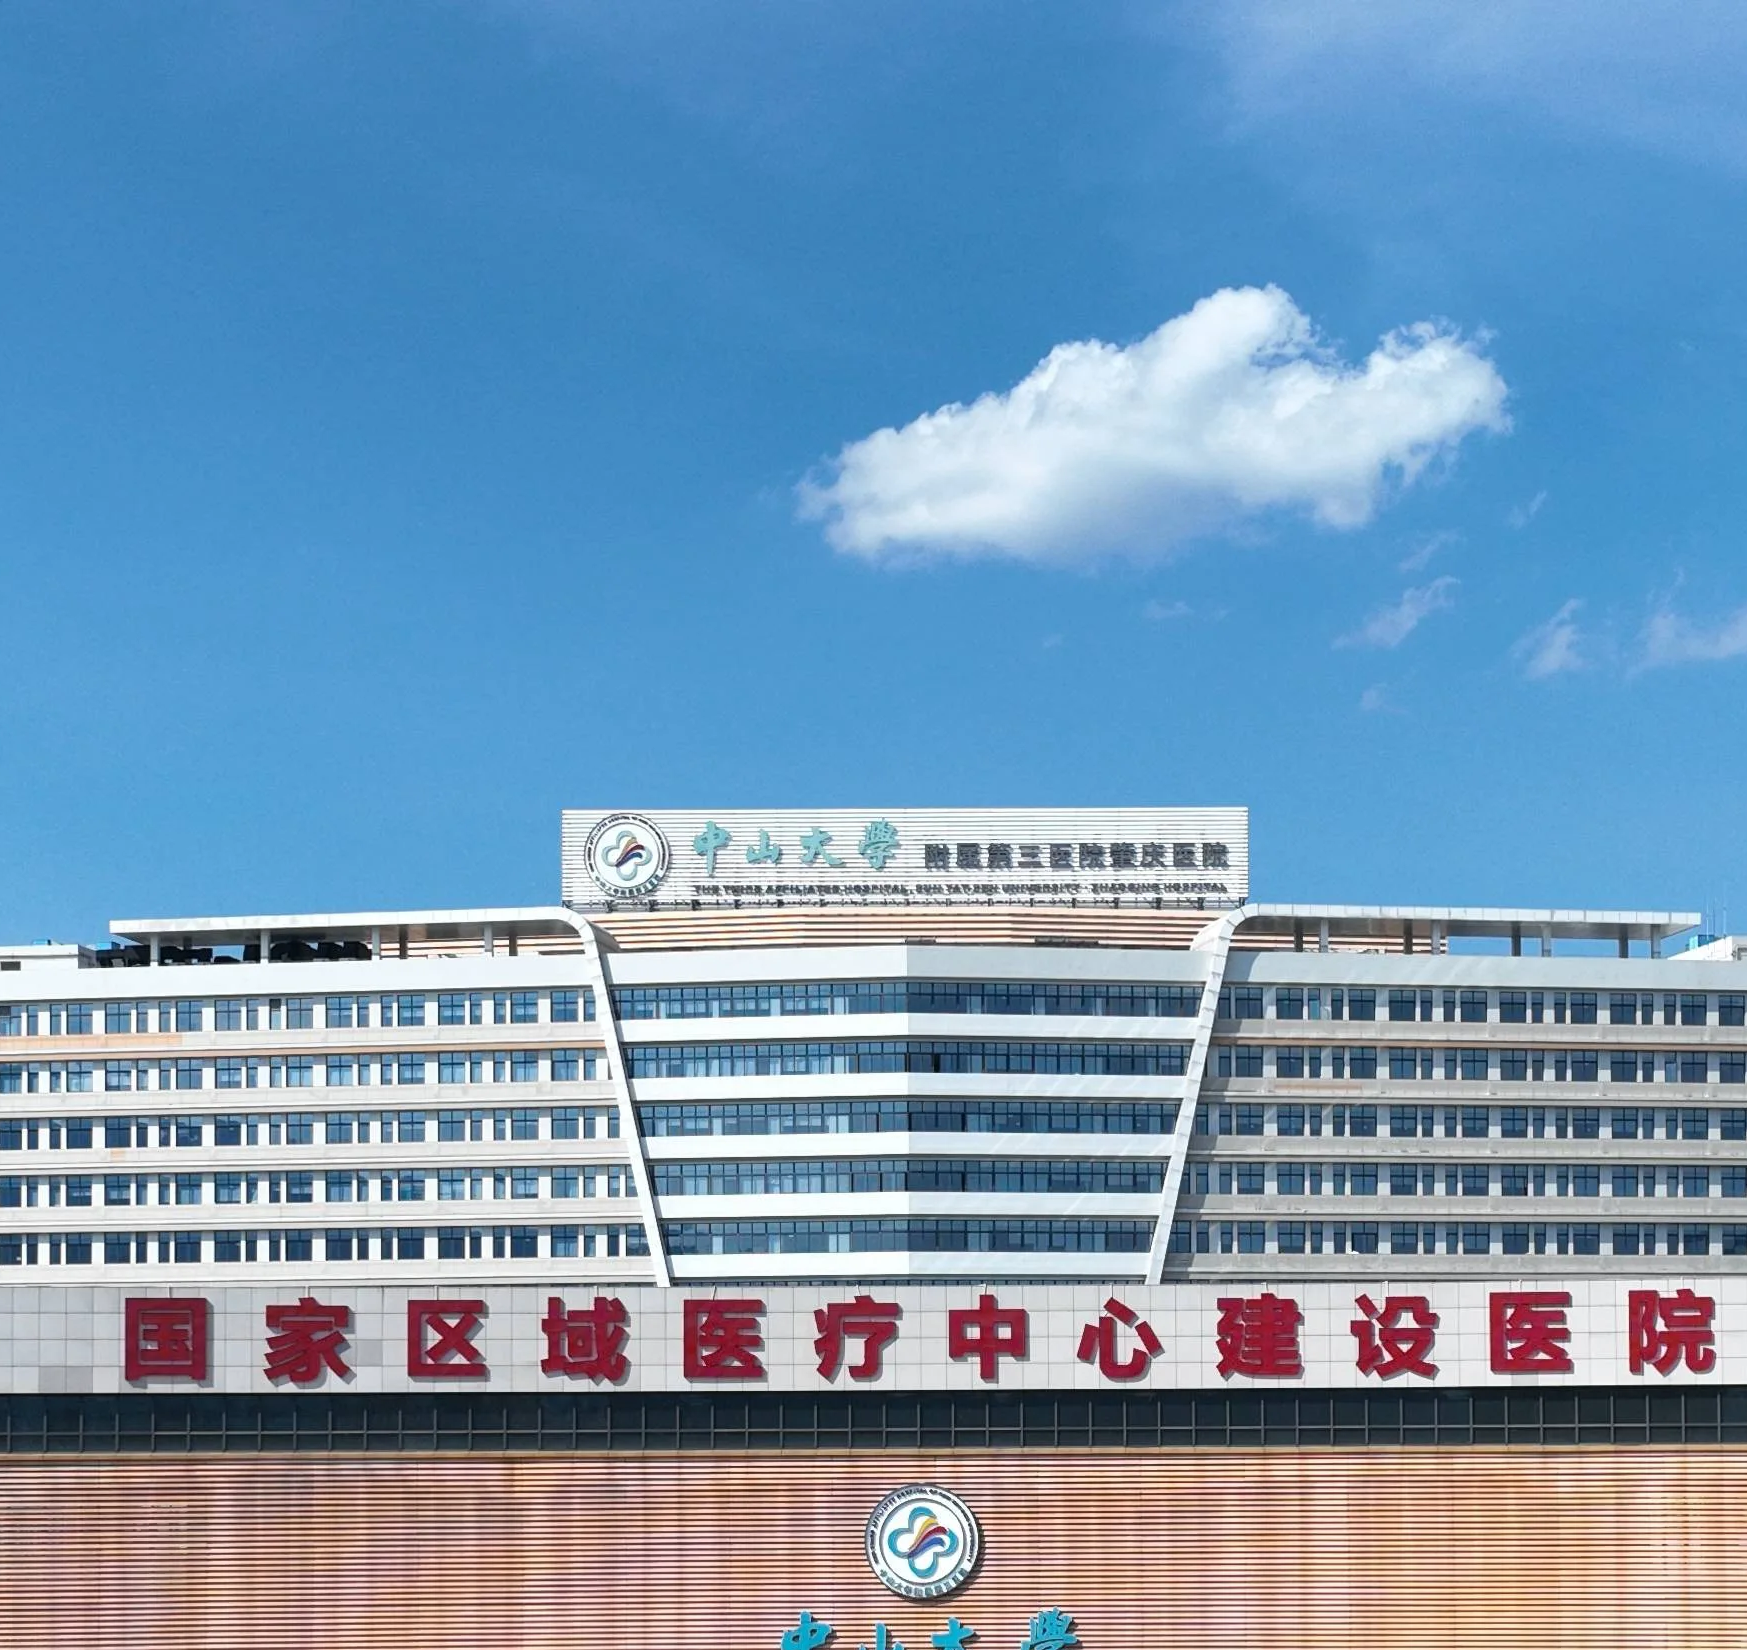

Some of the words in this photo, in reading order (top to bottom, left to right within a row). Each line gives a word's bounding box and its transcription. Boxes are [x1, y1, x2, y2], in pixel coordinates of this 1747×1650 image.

[123, 1288, 1715, 1382] 国家区域医疗中心建设医院
